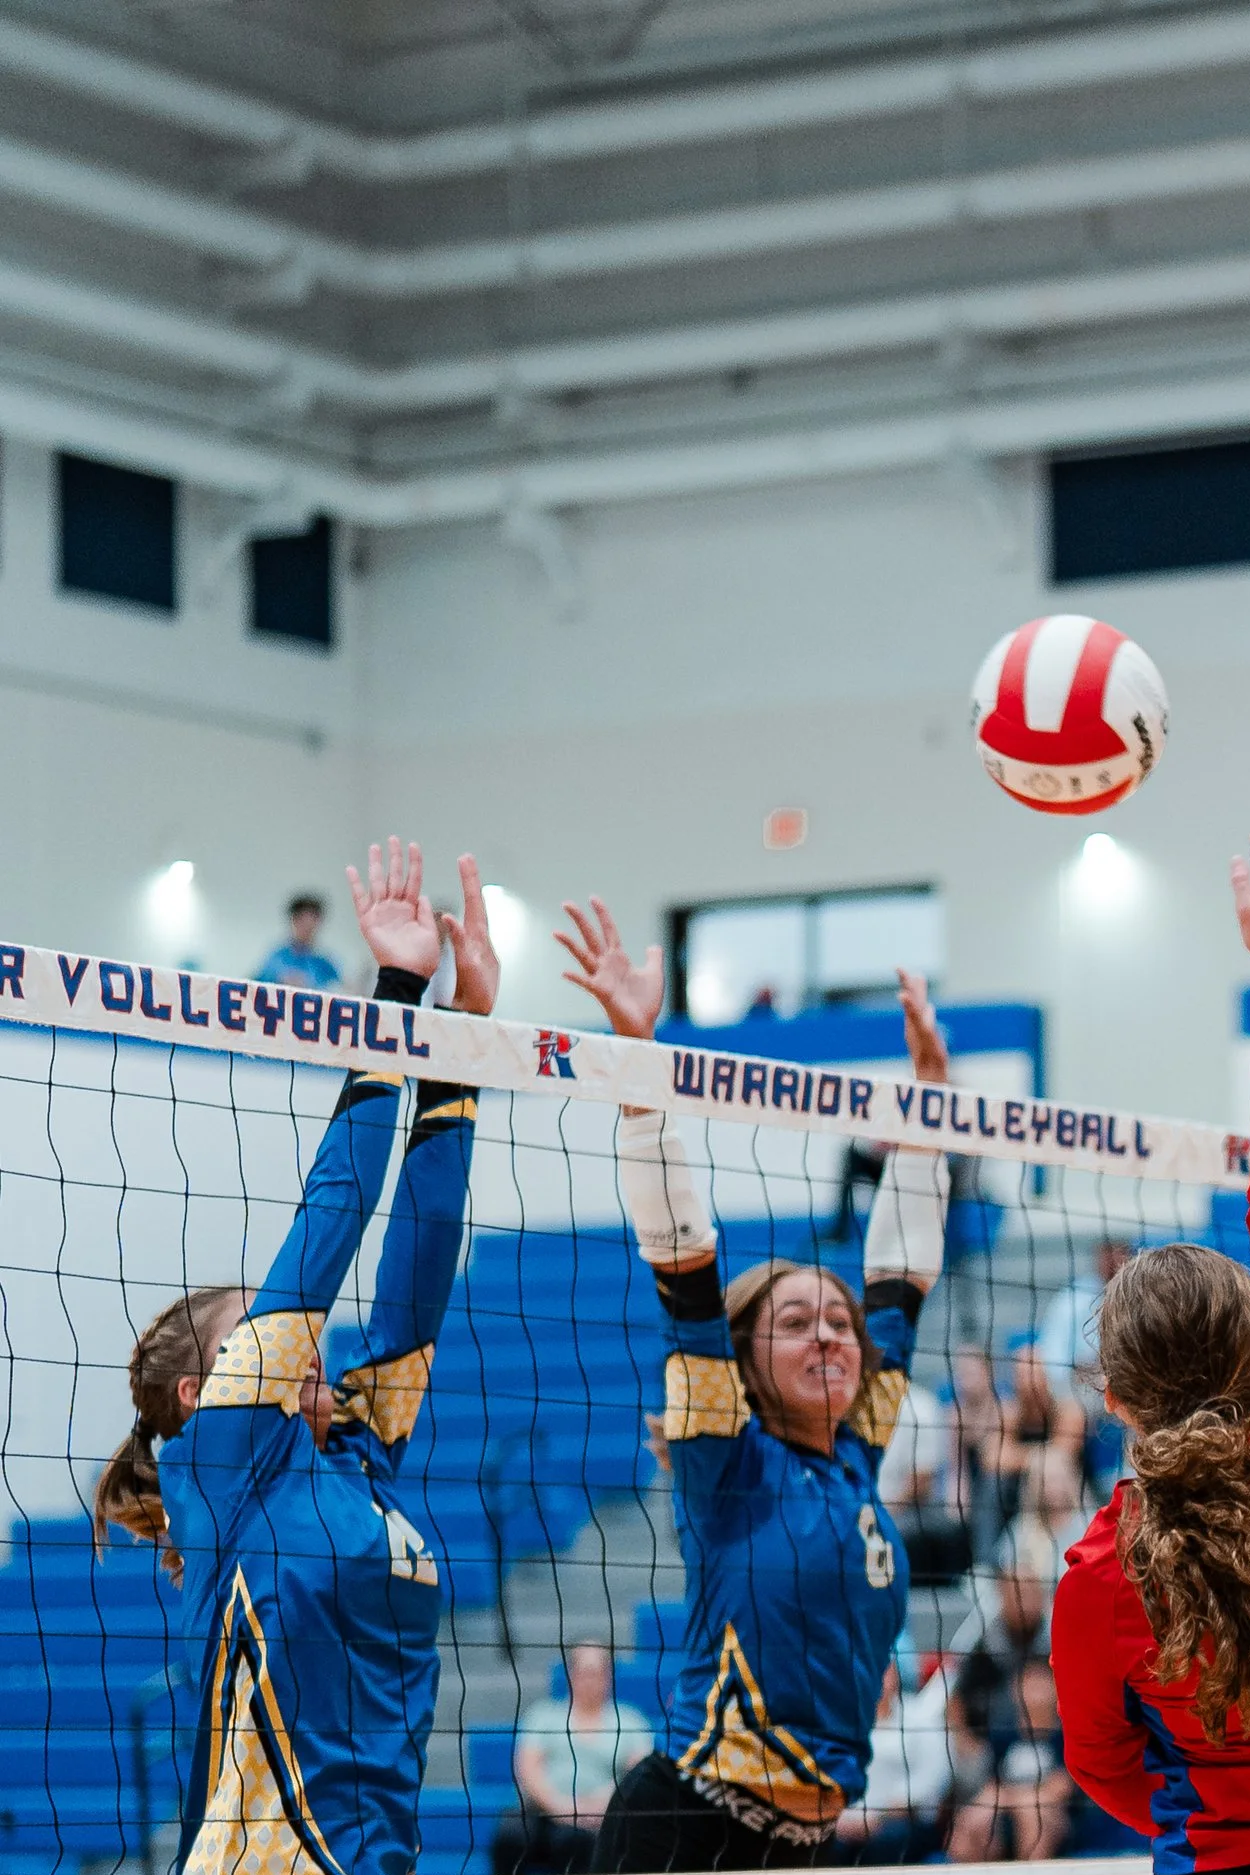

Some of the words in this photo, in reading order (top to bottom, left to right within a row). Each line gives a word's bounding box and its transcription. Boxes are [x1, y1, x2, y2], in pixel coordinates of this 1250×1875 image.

[57, 953, 432, 1059] VOLLEYBALL
[673, 1050, 874, 1119] WARRIOR
[895, 1084, 1151, 1160] VOLLEYBALL
